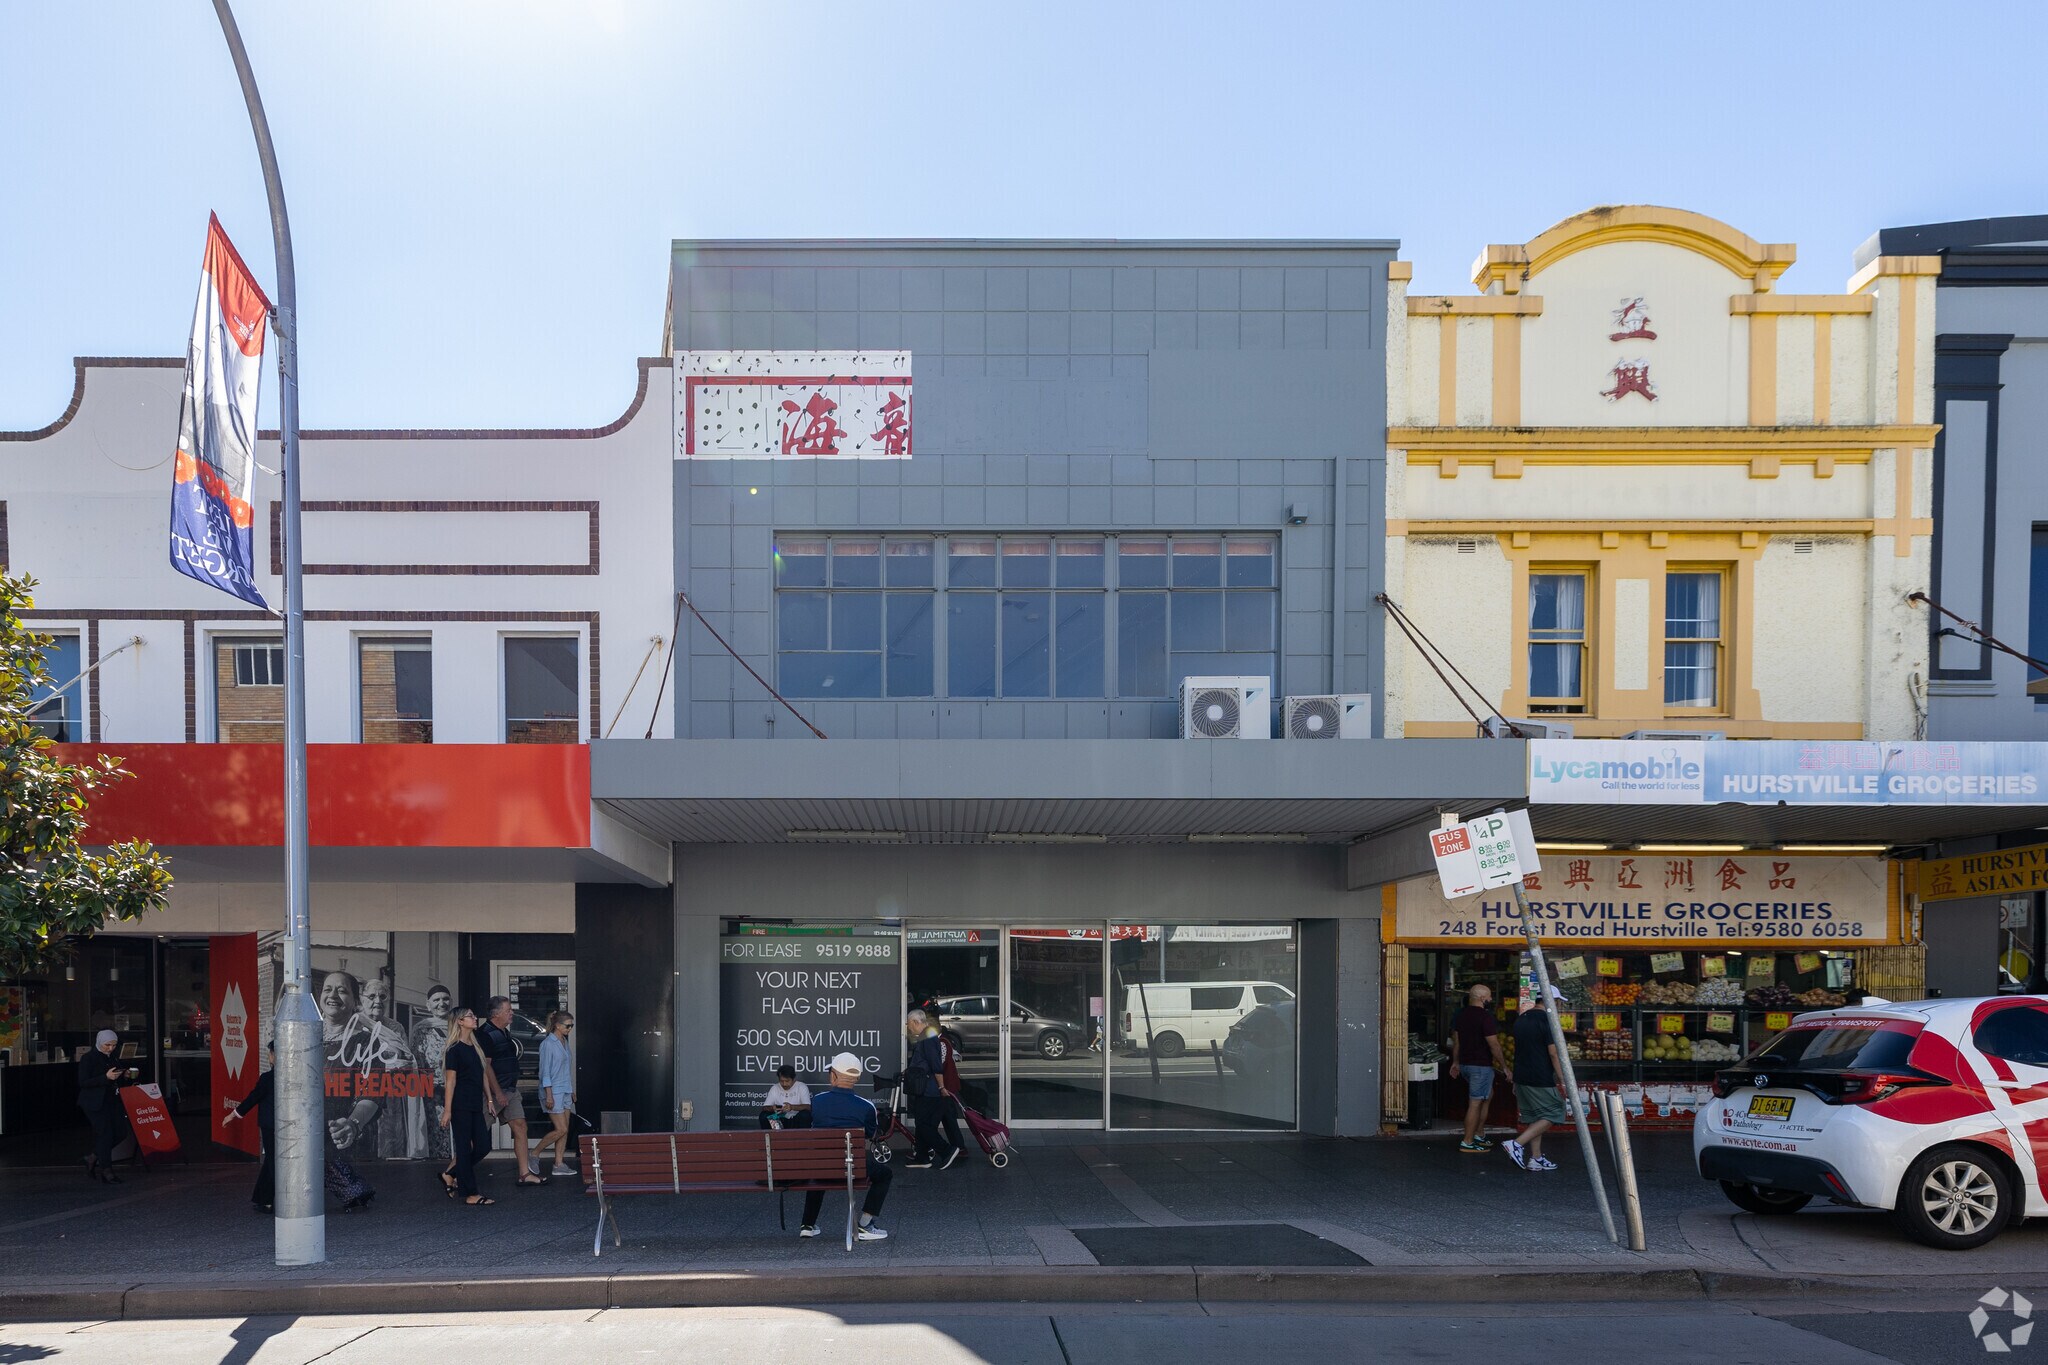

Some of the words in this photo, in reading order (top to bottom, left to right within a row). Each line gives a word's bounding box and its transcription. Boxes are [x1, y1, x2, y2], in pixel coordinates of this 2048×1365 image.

[1533, 755, 1700, 783] Lycamobile
[1601, 781, 1620, 790] Call
[1621, 781, 1636, 790] the
[1638, 781, 1665, 790] world
[1666, 781, 1680, 790] for
[1681, 781, 1700, 790] less
[1723, 774, 1879, 795] HURSTVILLE
[1888, 775, 2038, 795] GROCERIES
[1438, 831, 1462, 843] BUS
[1440, 841, 1466, 855] ZONE
[1927, 863, 1957, 897] 益
[1965, 871, 2024, 893] ASIAN
[1481, 902, 1651, 920] HURSTVILLE
[1664, 902, 1833, 920] GROCERIES
[1439, 921, 1477, 936] 248
[1555, 922, 1605, 936] Road
[1613, 922, 1708, 937] Hurstville
[1811, 922, 1863, 937] 6058
[724, 943, 754, 957] FOR
[758, 943, 801, 957] LEASE
[816, 944, 852, 958] 9519
[855, 944, 891, 958] 9888
[756, 971, 809, 989] YOUR
[814, 971, 862, 989] NEXT
[762, 997, 811, 1015] FLAG
[816, 997, 856, 1015] SHIP
[1834, 1019, 1884, 1027] TRANSPORT
[328, 1013, 398, 1078] life
[736, 1029, 771, 1046] 500
[776, 1029, 823, 1046] SQM
[829, 1029, 880, 1047] MULTI
[324, 1072, 351, 1097] HE
[354, 1072, 434, 1098] REASON
[747, 1091, 768, 1099] Tripod
[136, 1107, 149, 1115] Give
[137, 1116, 149, 1125] Give
[1733, 1119, 1763, 1131] Pathology
[1722, 1136, 1797, 1152] www.4cyte.com.au
